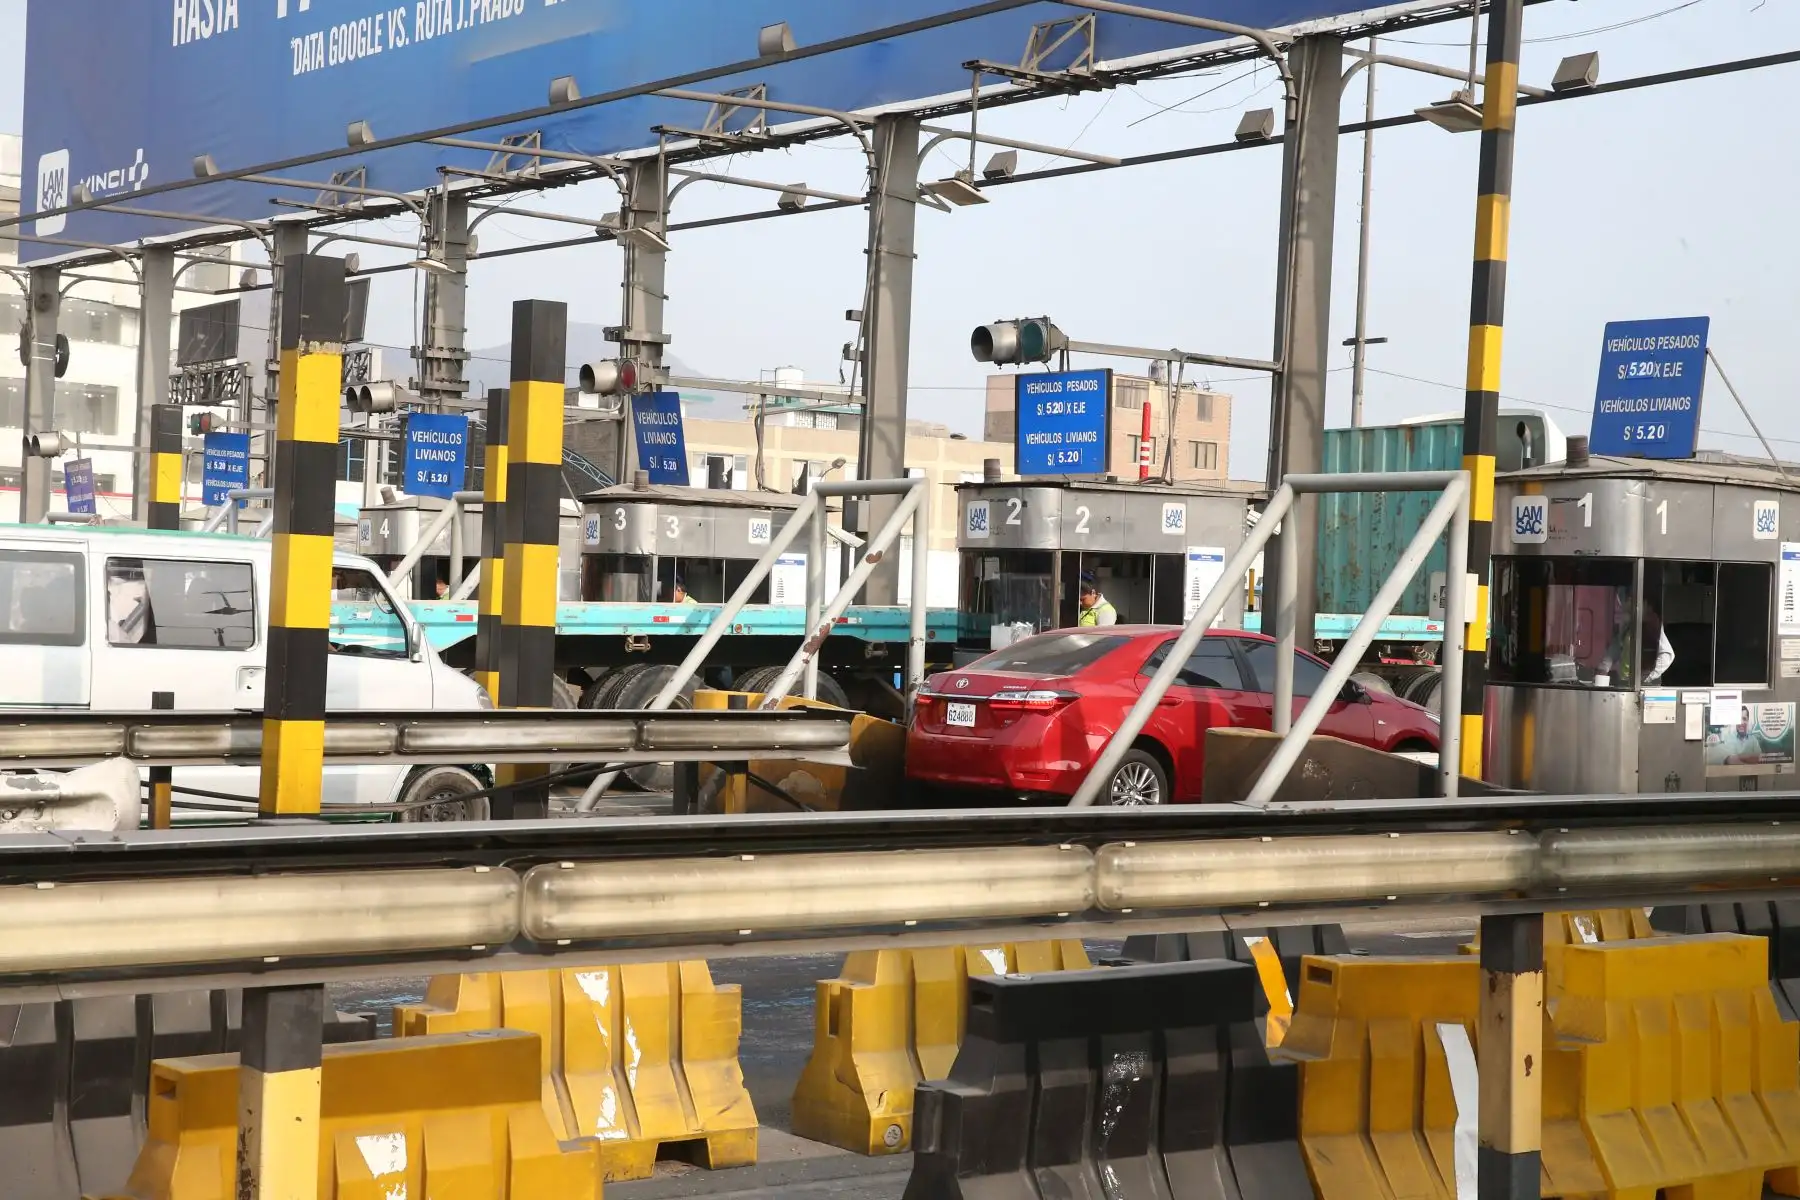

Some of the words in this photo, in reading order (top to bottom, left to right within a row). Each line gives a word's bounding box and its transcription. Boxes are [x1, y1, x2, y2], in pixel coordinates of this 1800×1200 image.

[173, 0, 239, 47] HASTA
[328, 12, 384, 66] GOOGLE
[388, 6, 409, 50] VS.
[415, 0, 452, 42] RUTA
[1607, 335, 1655, 352] VEHÍCULOS
[1657, 335, 1700, 350] PESADOS
[1629, 361, 1654, 376] 5.20
[1654, 362, 1661, 378] X
[1663, 361, 1684, 378] EJE
[1026, 380, 1062, 394] VEHÍCULOS
[1066, 380, 1098, 392] PESADOS
[1046, 401, 1063, 414] 5.20
[1066, 402, 1072, 415] X
[1073, 402, 1086, 414] EJE
[1600, 397, 1648, 413] VEHÍCULOS
[1650, 397, 1691, 411] LIVIANOS
[636, 409, 679, 425] VEHÍCULOS
[412, 430, 462, 445] VEHÍCULOS
[643, 431, 677, 445] LIVIANOS
[1026, 431, 1062, 445] VEHÍCULOS
[1065, 431, 1097, 443] LIVIANOS
[1636, 425, 1665, 440] 5.20
[415, 449, 456, 462] LIVIANOS
[1058, 451, 1079, 463] 5.20
[213, 461, 226, 470] 5.20
[232, 465, 244, 473] EJE
[663, 460, 677, 471] 5.20
[417, 470, 429, 482] S/.
[431, 473, 448, 483] 5.20
[970, 508, 987, 520] LAM
[1006, 497, 1022, 525] 2
[1165, 509, 1182, 519] LAM
[1516, 505, 1543, 520] LAM
[1577, 492, 1593, 528] 1
[1656, 500, 1668, 535] 1
[1757, 508, 1776, 520] LAM
[614, 507, 627, 531] 3
[1075, 505, 1090, 534] 2
[380, 518, 390, 539] 4
[666, 516, 680, 539] 3
